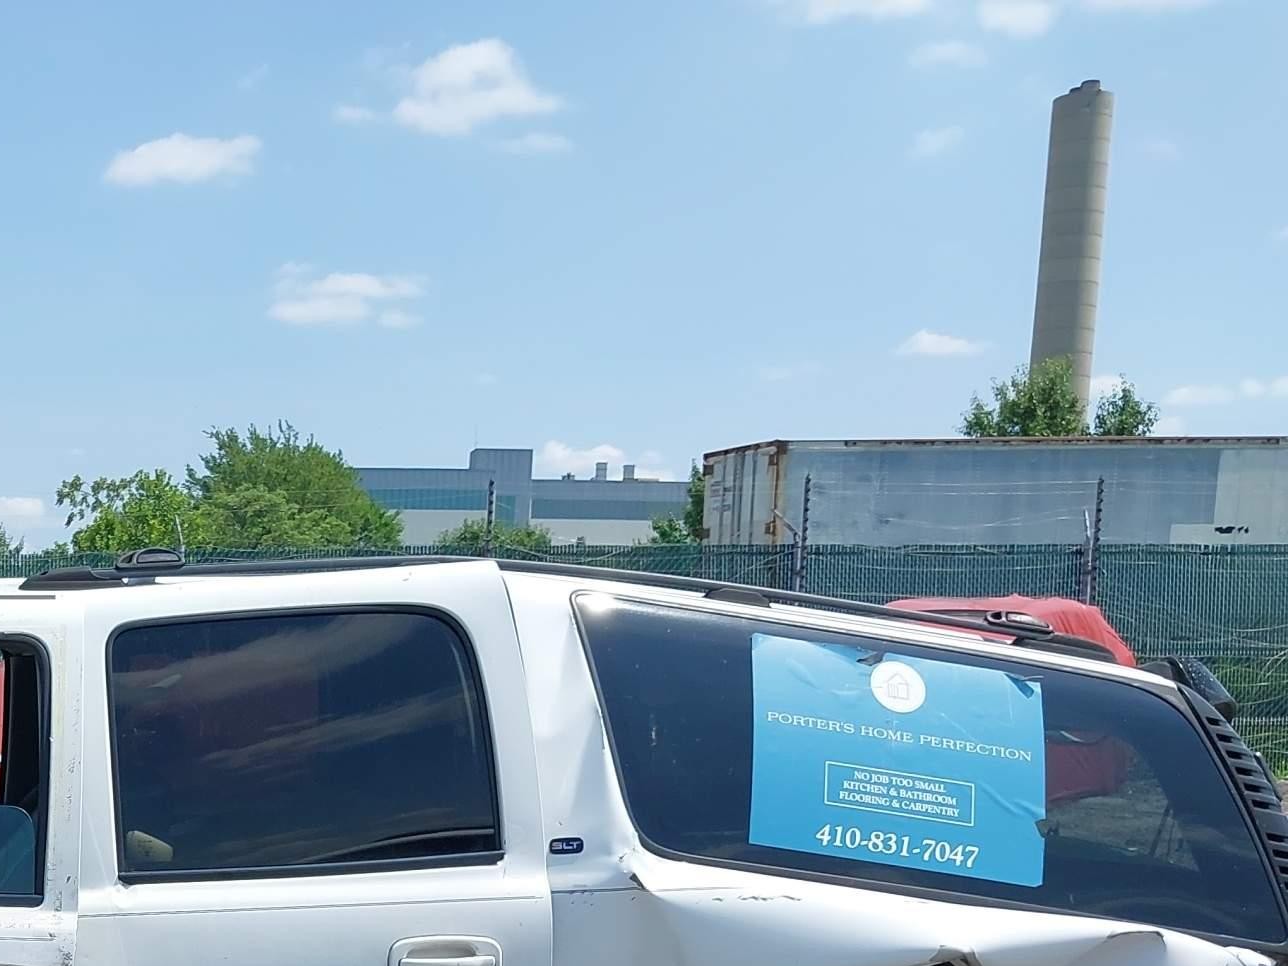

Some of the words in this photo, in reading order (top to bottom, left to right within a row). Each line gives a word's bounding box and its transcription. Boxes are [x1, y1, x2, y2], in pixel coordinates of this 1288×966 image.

[767, 711, 854, 734] PORTER'S
[861, 725, 914, 743] HOME
[919, 735, 1032, 762] PERFECTION
[843, 780, 887, 795] KITCHEN
[889, 787, 898, 797] &
[899, 789, 957, 806] BATHROOM
[854, 770, 870, 780] NO
[871, 774, 889, 784] JOB
[891, 776, 912, 788] TOO
[915, 780, 947, 793] SMALL
[839, 791, 889, 806] FLOORING
[891, 800, 901, 808] &
[901, 801, 960, 817] CARPENTRY
[552, 841, 581, 850] SLT
[815, 823, 979, 868] 410-831-7047
